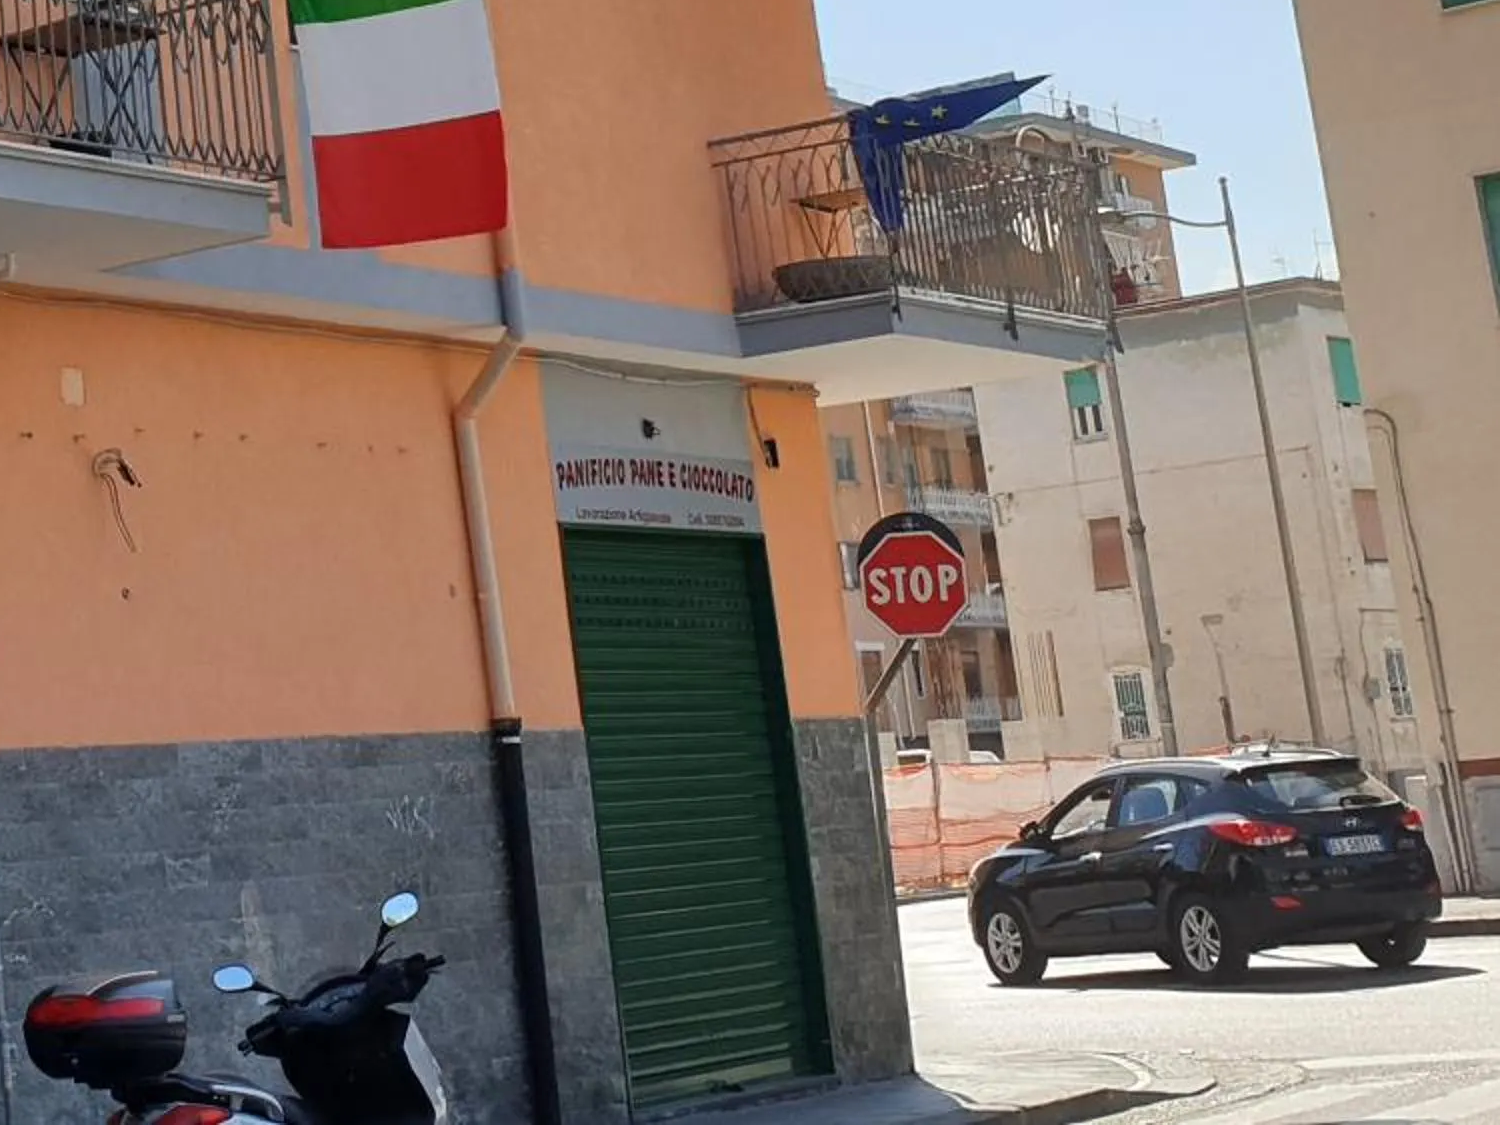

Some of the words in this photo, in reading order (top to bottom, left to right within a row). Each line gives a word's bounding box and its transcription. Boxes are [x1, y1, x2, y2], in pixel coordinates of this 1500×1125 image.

[556, 458, 626, 491] PANIFICIO
[630, 458, 663, 488] PANE
[668, 462, 677, 488] E
[680, 463, 754, 503] CIOCCOLATO
[868, 563, 959, 606] STOP
